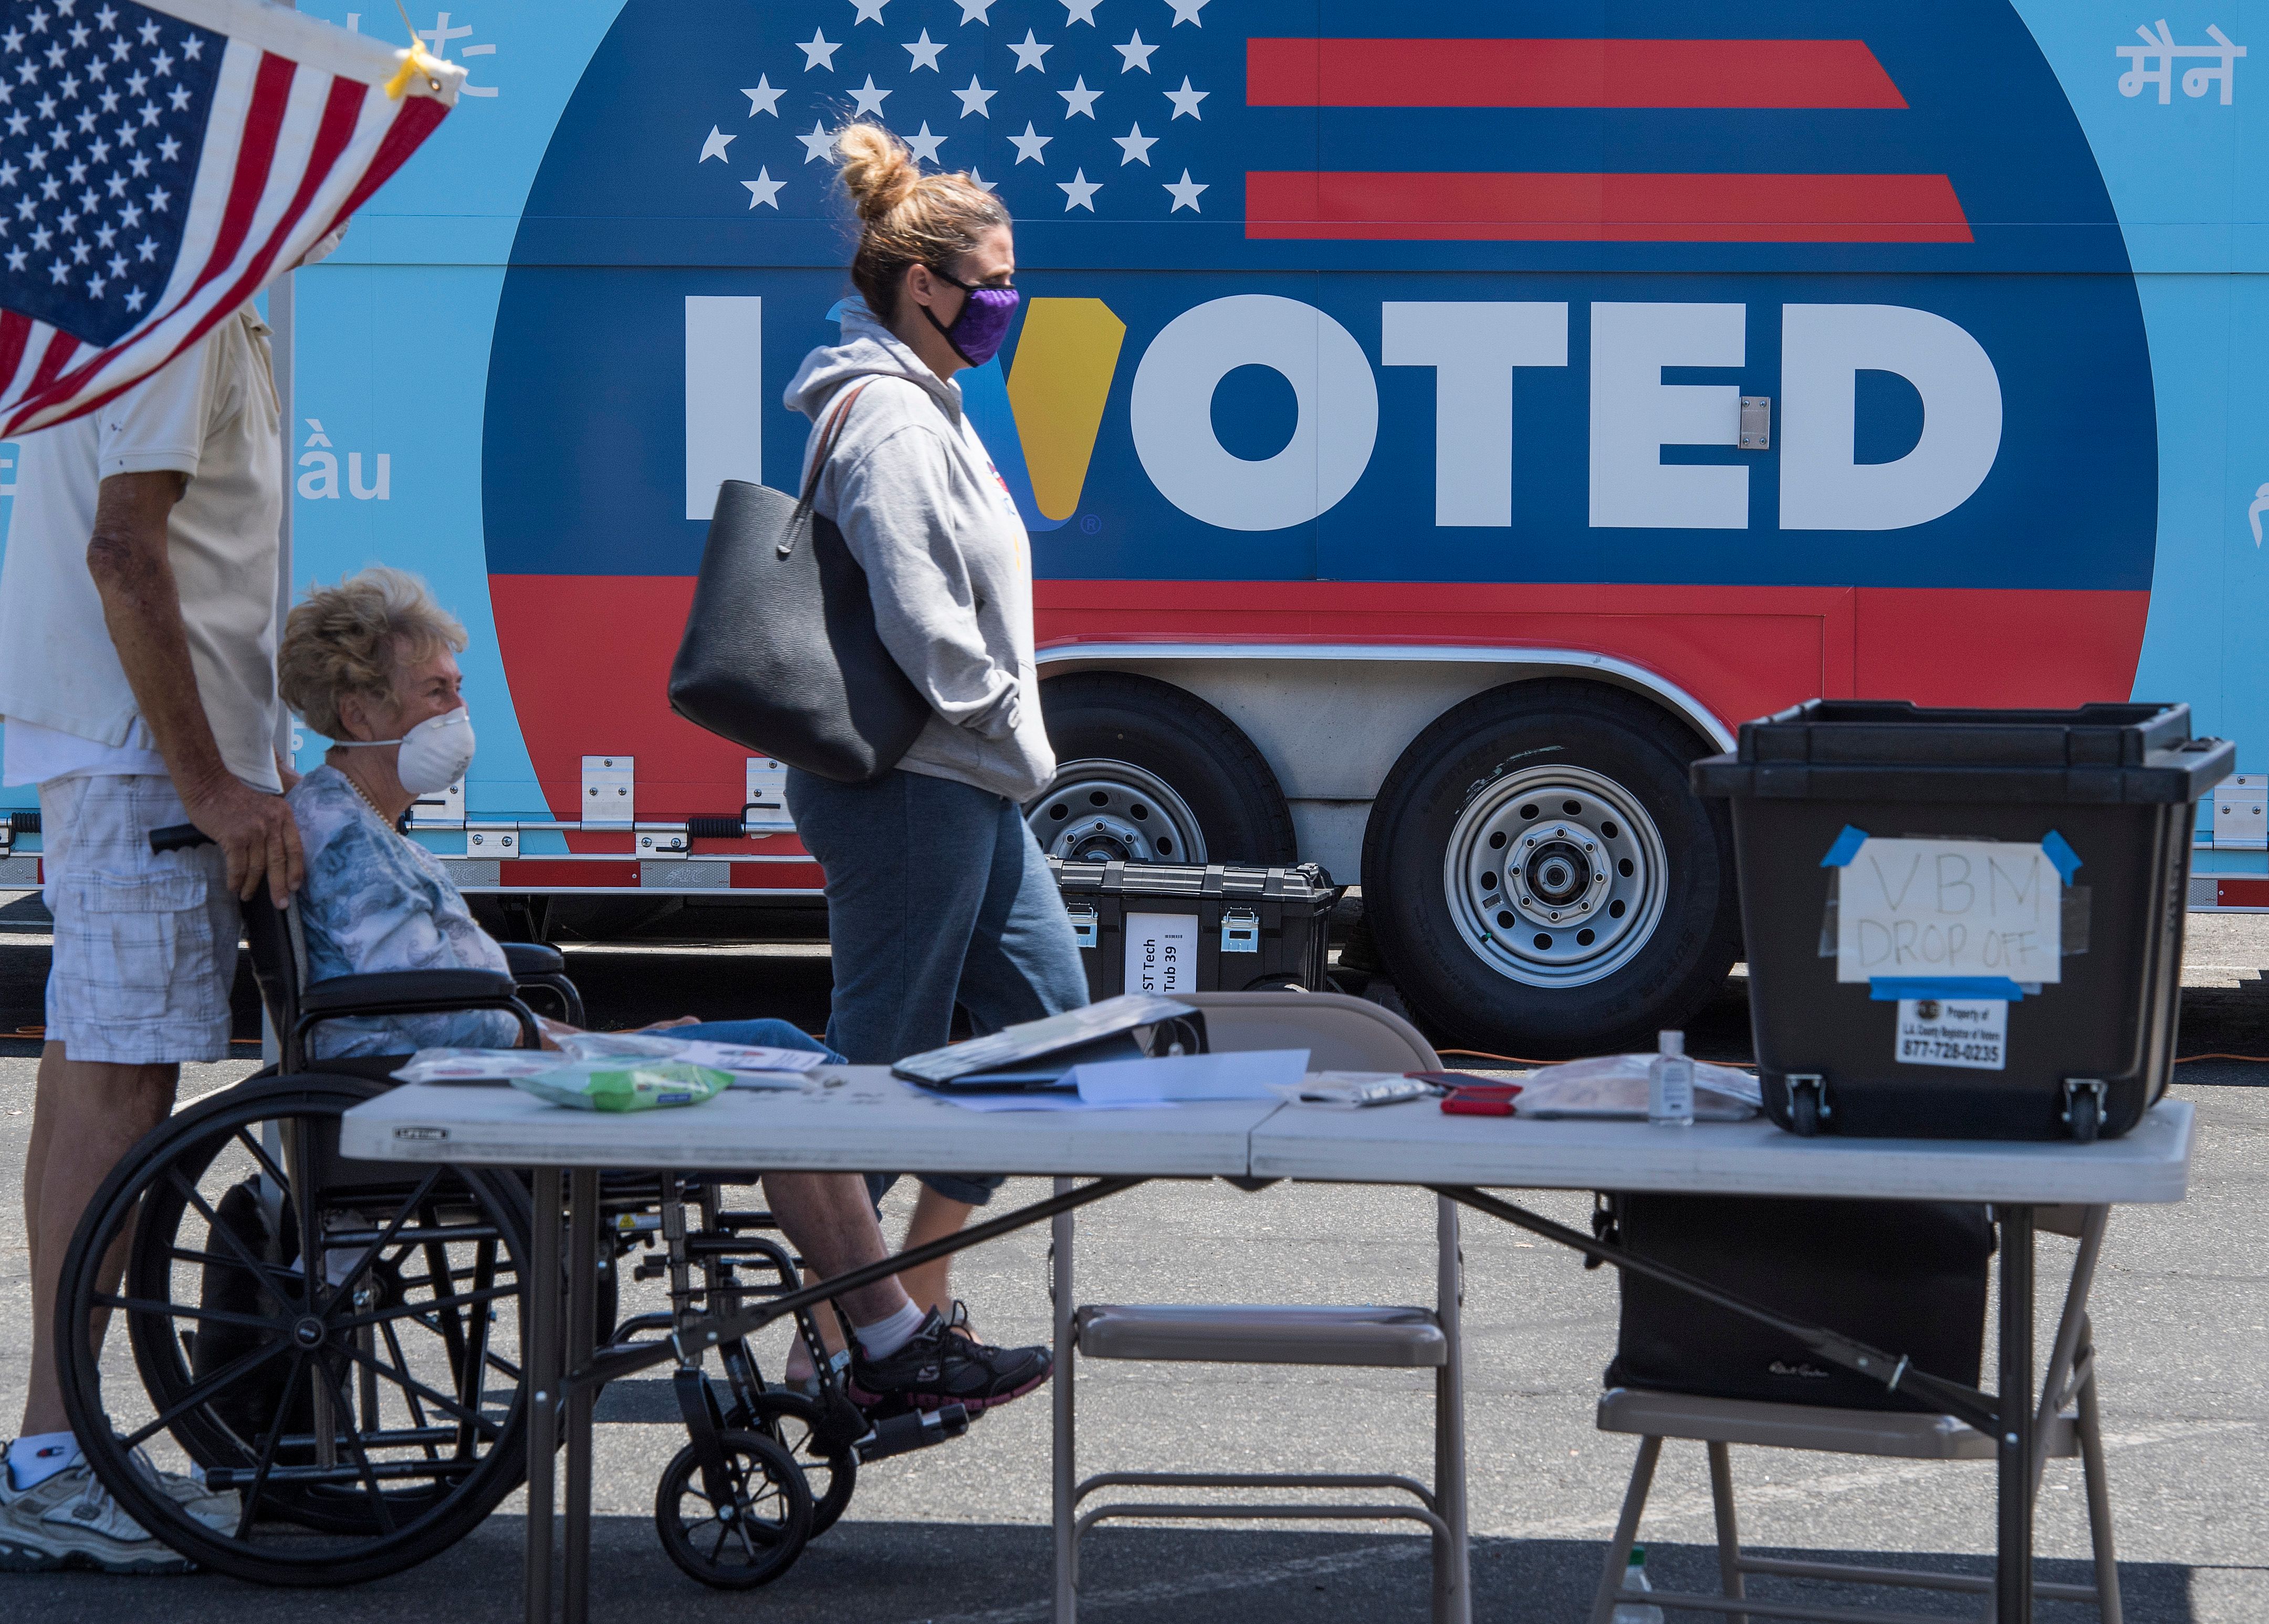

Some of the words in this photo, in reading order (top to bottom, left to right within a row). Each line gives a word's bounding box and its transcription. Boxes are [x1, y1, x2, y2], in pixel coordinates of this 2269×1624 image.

[685, 296, 762, 520] I
[825, 294, 2003, 532] VOTED
[1869, 853, 2040, 923] VBM
[1143, 939, 1155, 970] Tech
[1165, 946, 1176, 962] 39
[1858, 918, 1968, 967] DROP
[1982, 929, 2038, 968] OFF
[1143, 974, 1154, 993] ST
[1164, 967, 1176, 992] Tub
[1948, 1006, 1979, 1022] Property
